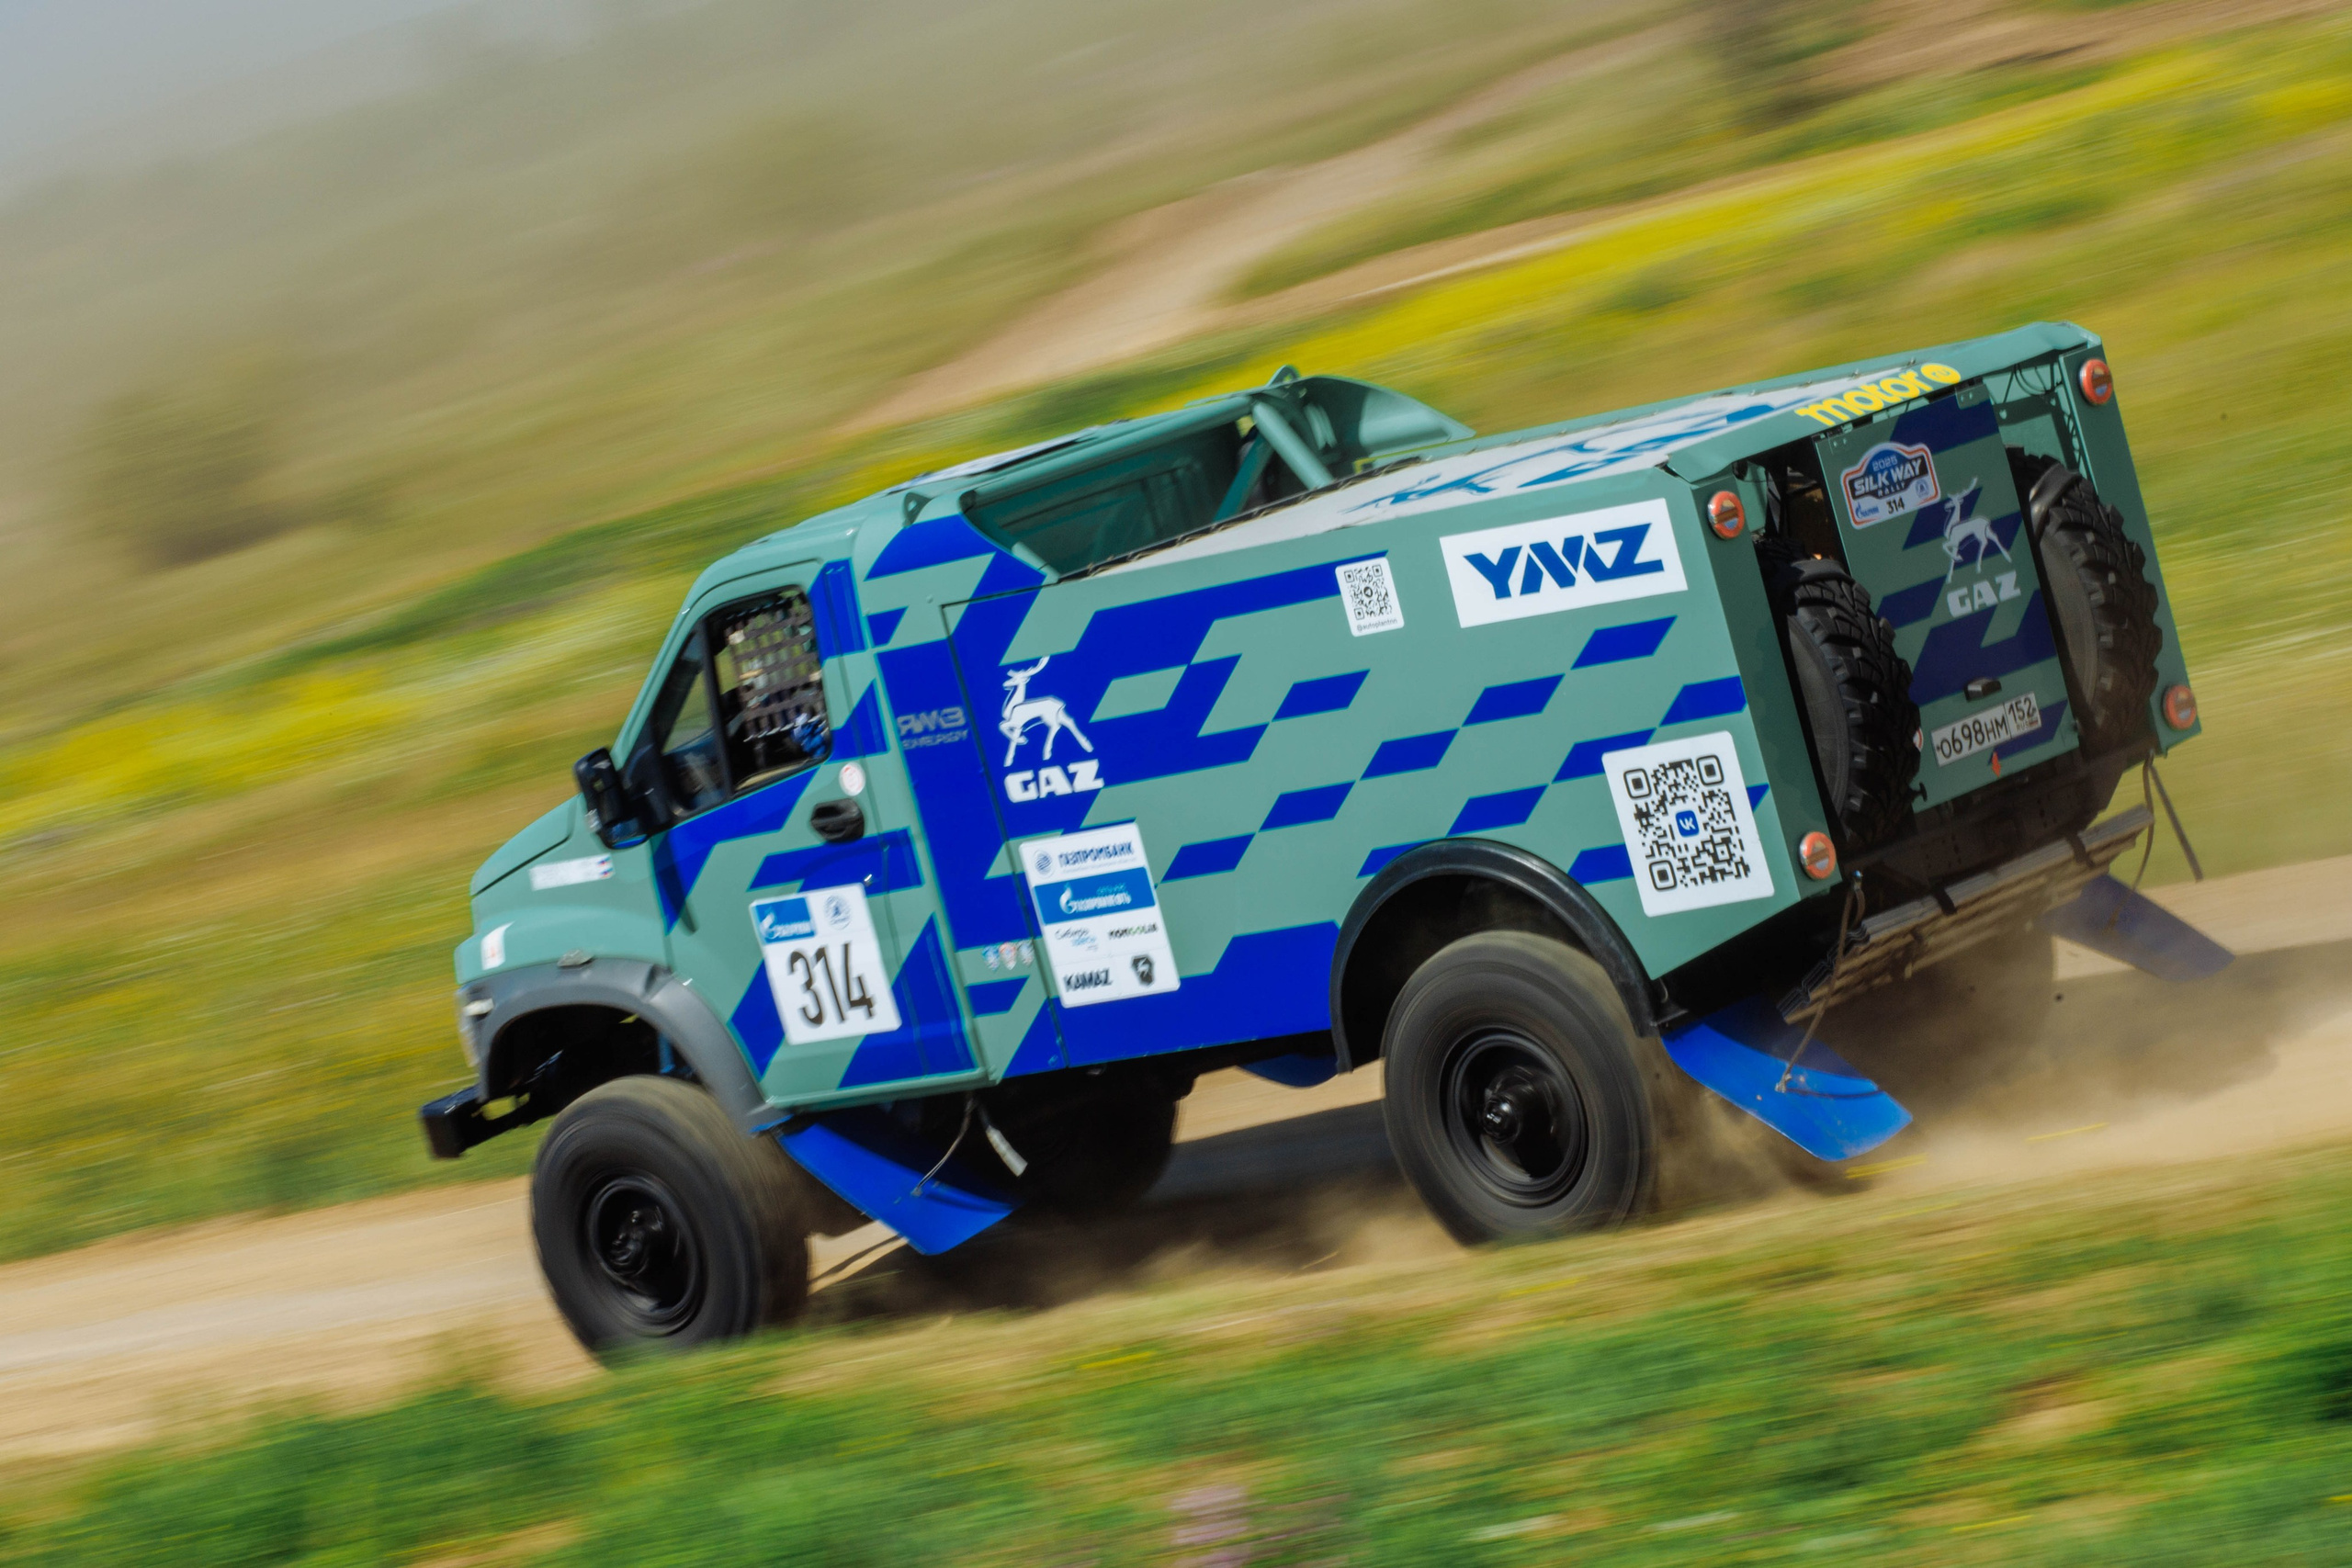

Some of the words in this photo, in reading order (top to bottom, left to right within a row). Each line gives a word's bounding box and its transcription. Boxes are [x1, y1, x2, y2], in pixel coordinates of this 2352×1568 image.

[1794, 370, 1934, 426] motor
[1854, 470, 1889, 497] SILK
[1891, 458, 1920, 483] WAY
[1886, 496, 1905, 514] 314
[1947, 570, 2021, 618] GAZ
[2007, 697, 2032, 724] 152
[1004, 759, 1104, 803] GAZ
[1679, 817, 1696, 831] VK
[787, 941, 876, 1027] 314
[1063, 968, 1113, 992] KAMAZ
